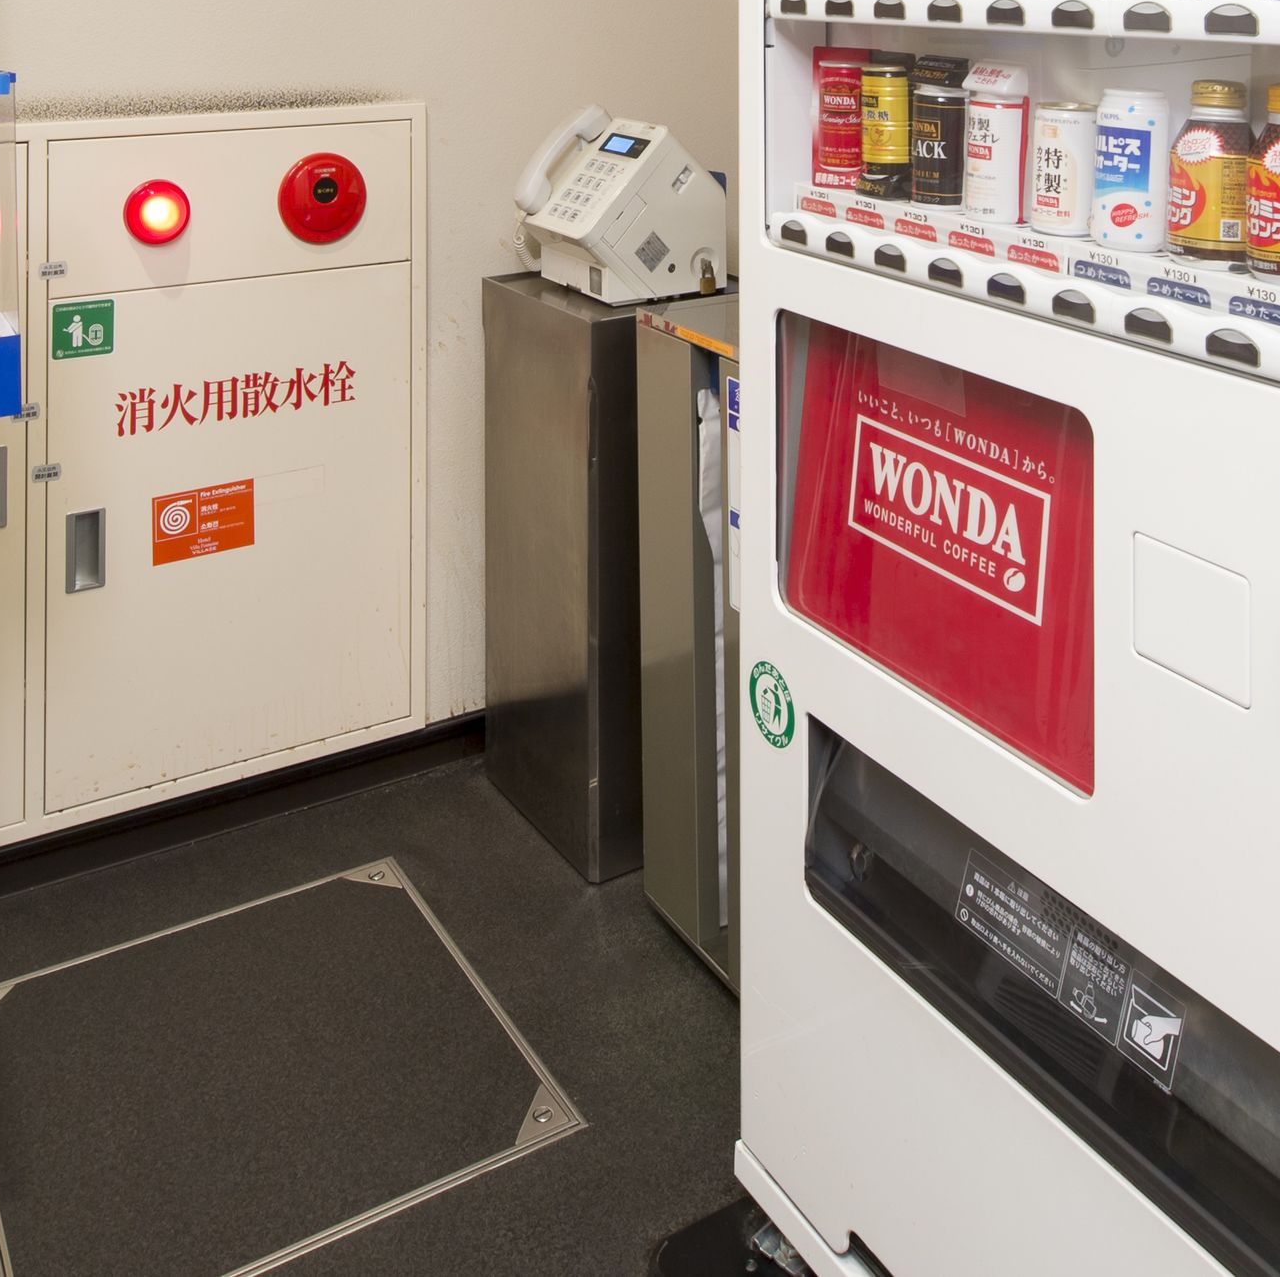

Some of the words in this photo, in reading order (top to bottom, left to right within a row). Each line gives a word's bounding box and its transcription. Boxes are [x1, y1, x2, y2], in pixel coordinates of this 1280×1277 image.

[824, 95, 856, 105] WONDA
[913, 123, 937, 134] ONDA
[912, 141, 947, 160] ACK
[1096, 135, 1141, 156] ルピス
[1044, 147, 1062, 194] 特製
[1022, 238, 1044, 248] ¥130
[1090, 251, 1114, 266] ¥130
[1164, 268, 1190, 282] ¥130
[1248, 286, 1277, 303] ¥130
[114, 359, 356, 438] 消火用散水栓
[869, 441, 1026, 565] WONDA
[864, 498, 937, 549] WONDERFUL
[943, 539, 996, 578] COFFEE
